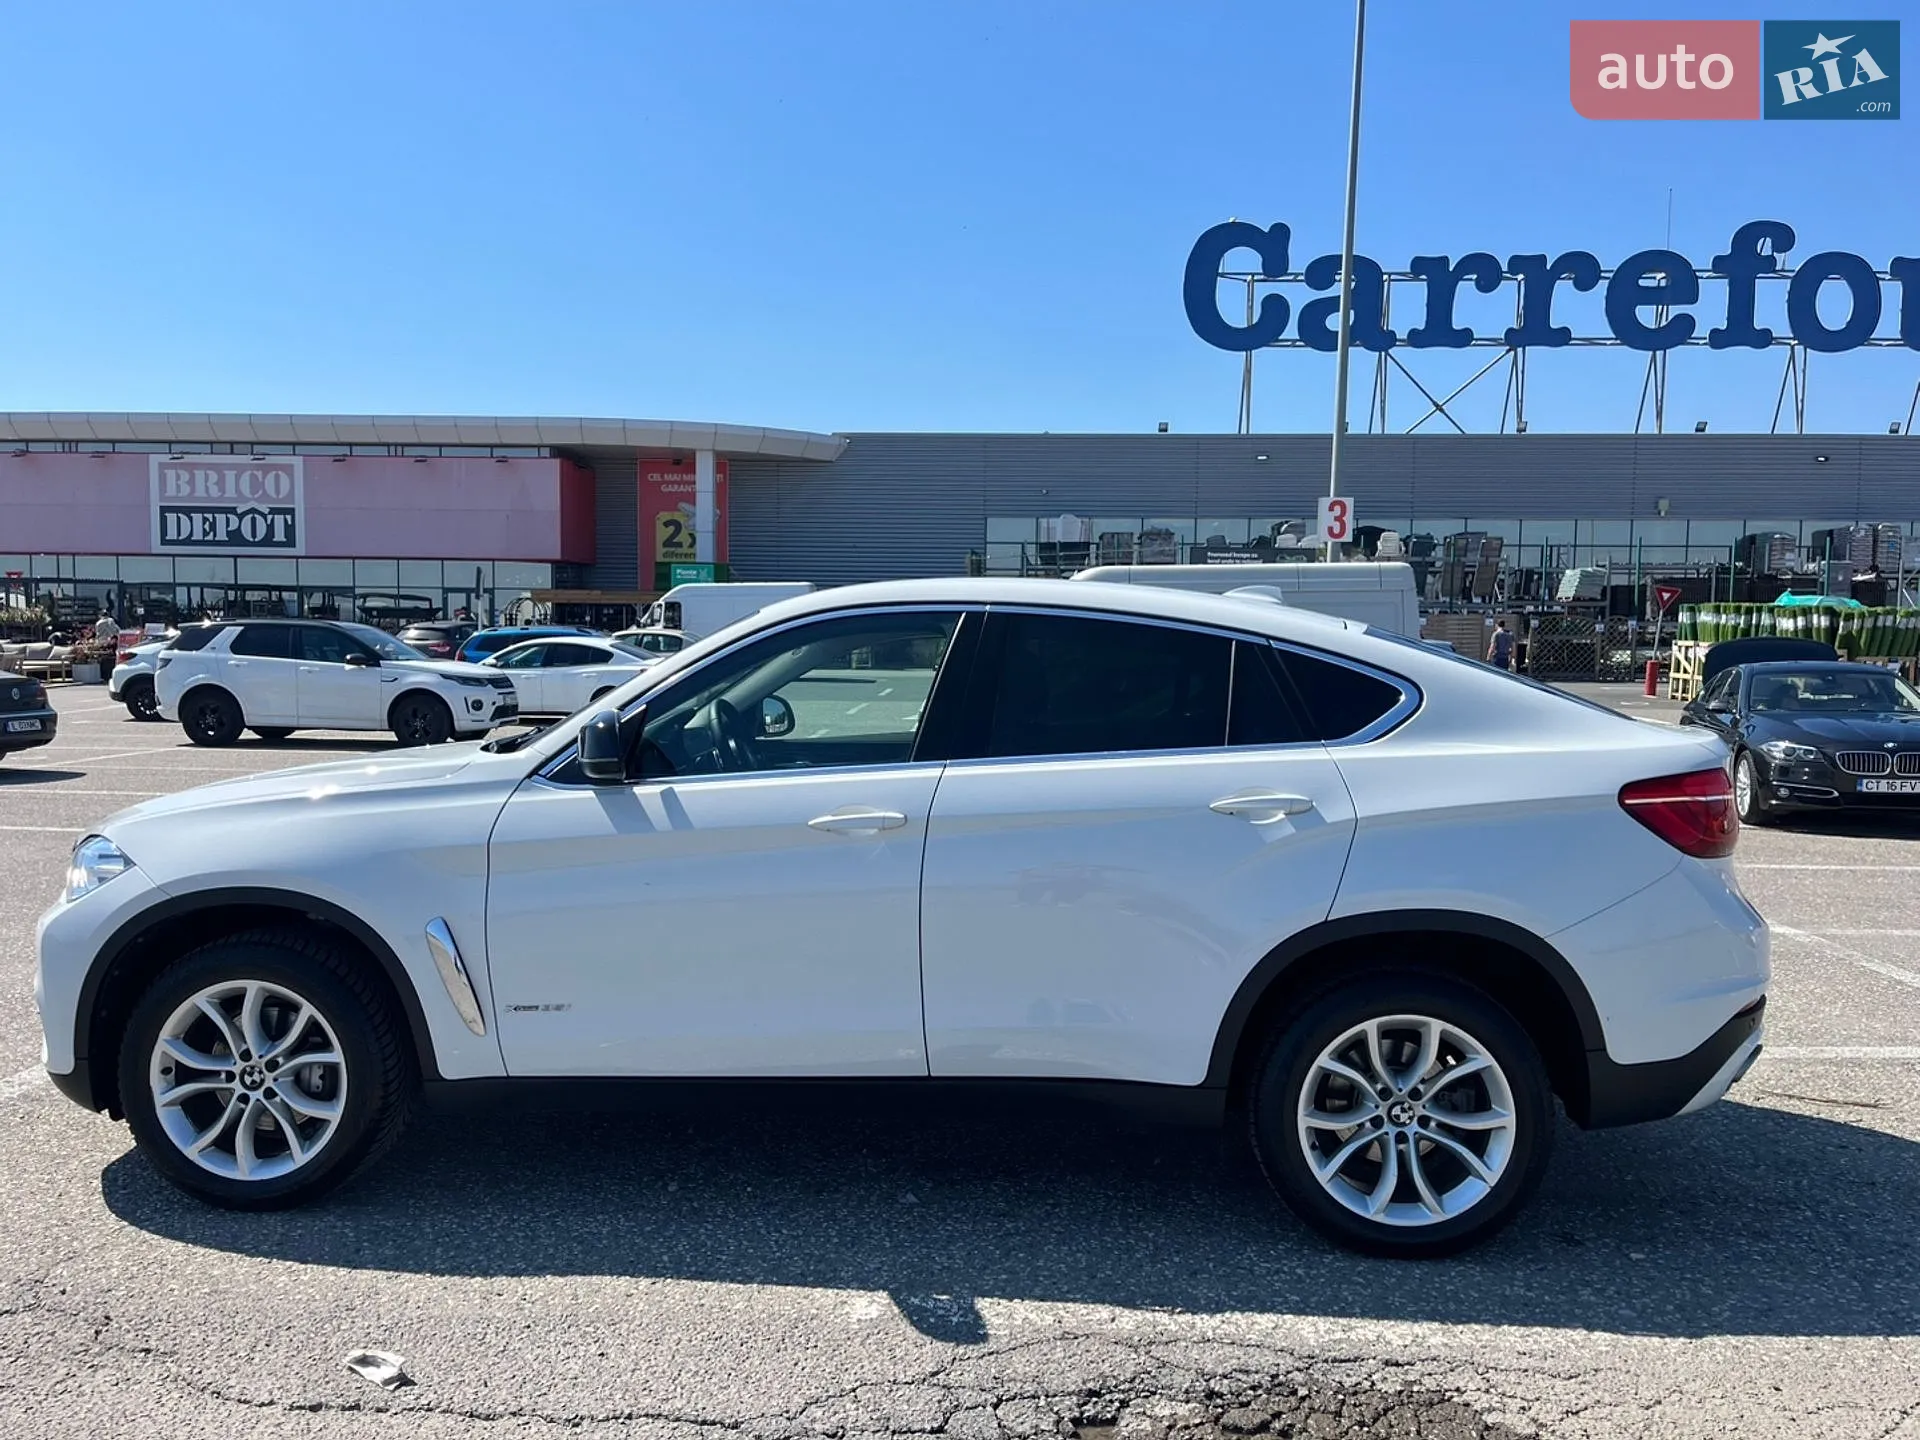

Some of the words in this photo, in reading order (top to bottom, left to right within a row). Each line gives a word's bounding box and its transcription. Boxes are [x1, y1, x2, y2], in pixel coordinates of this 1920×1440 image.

[164, 469, 291, 499] BRICO
[1327, 499, 1347, 540] 3
[662, 550, 696, 559] diferen
[1865, 780, 1881, 791] CT
[1886, 781, 1898, 792] 16
[1900, 781, 1920, 791] FV
